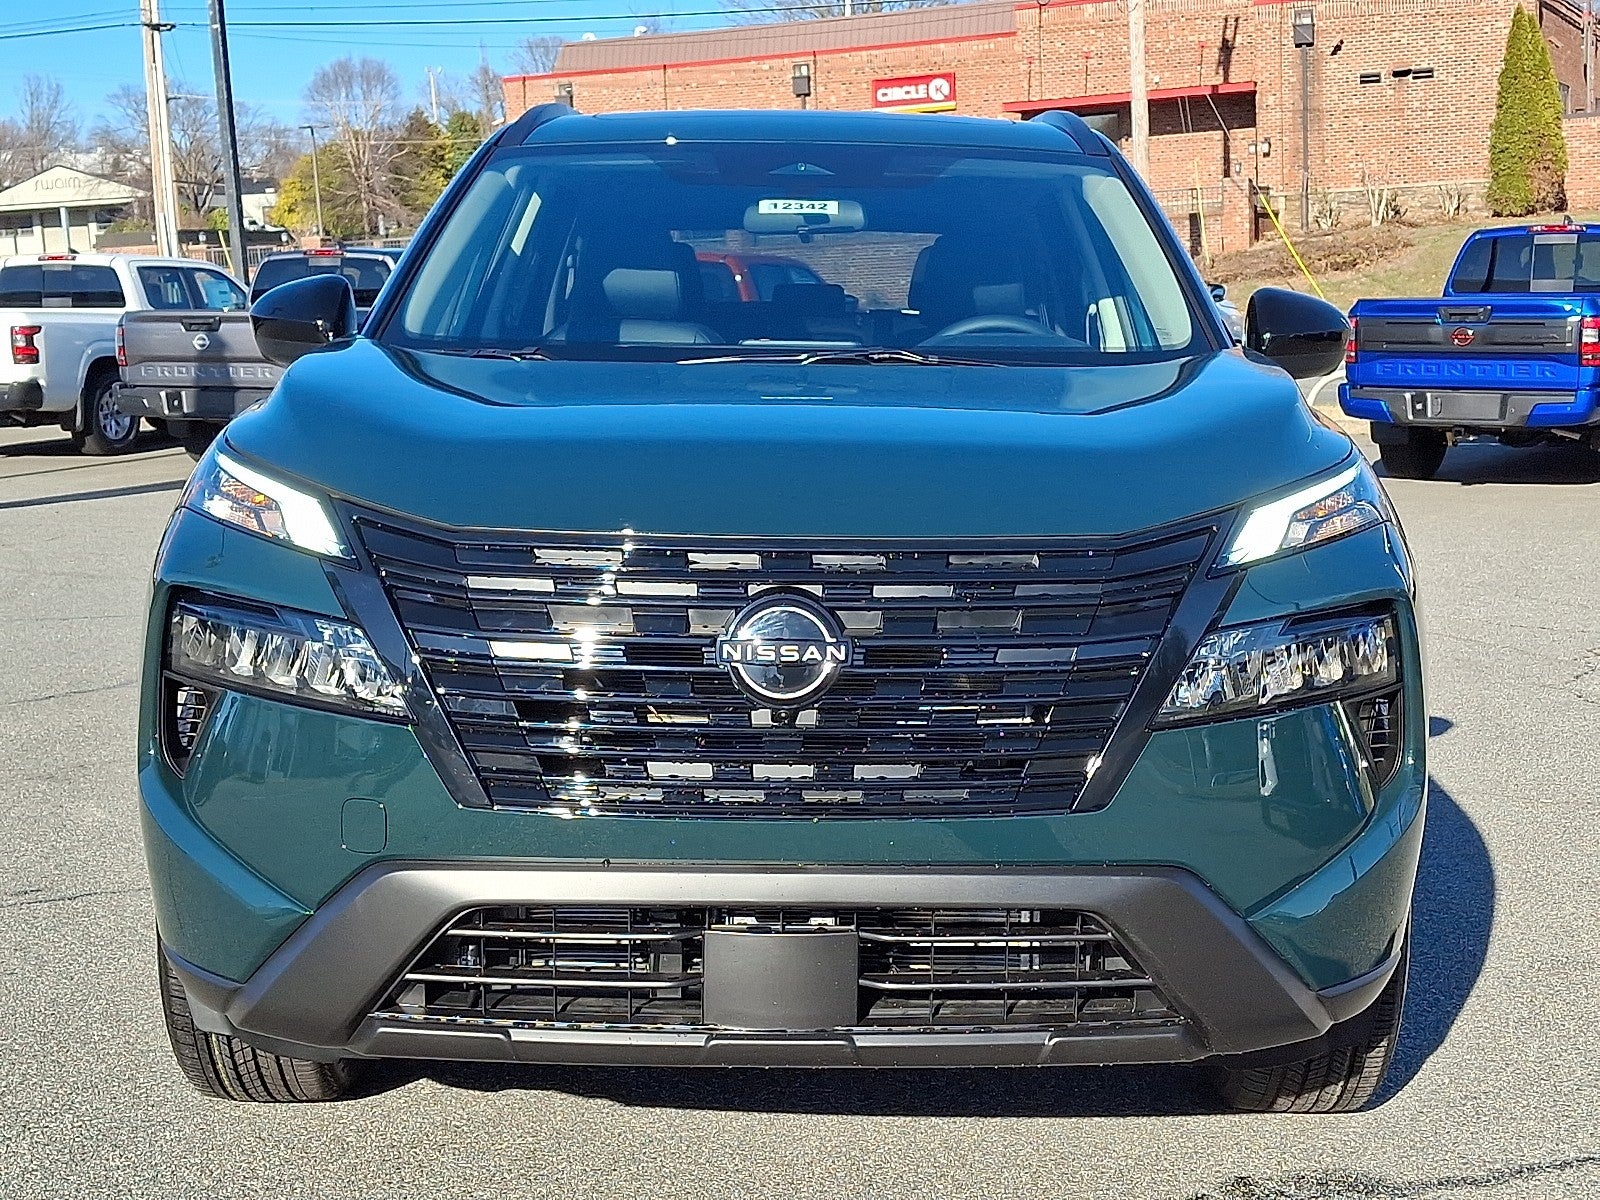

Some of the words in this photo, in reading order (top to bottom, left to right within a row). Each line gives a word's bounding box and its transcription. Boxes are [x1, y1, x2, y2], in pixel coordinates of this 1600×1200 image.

[876, 84, 927, 101] CIRCLE
[932, 81, 949, 99] K
[768, 202, 829, 211] 12342
[141, 365, 274, 378] FRONTIER
[1376, 362, 1557, 378] FRONTIER
[722, 643, 846, 662] NISSAN
